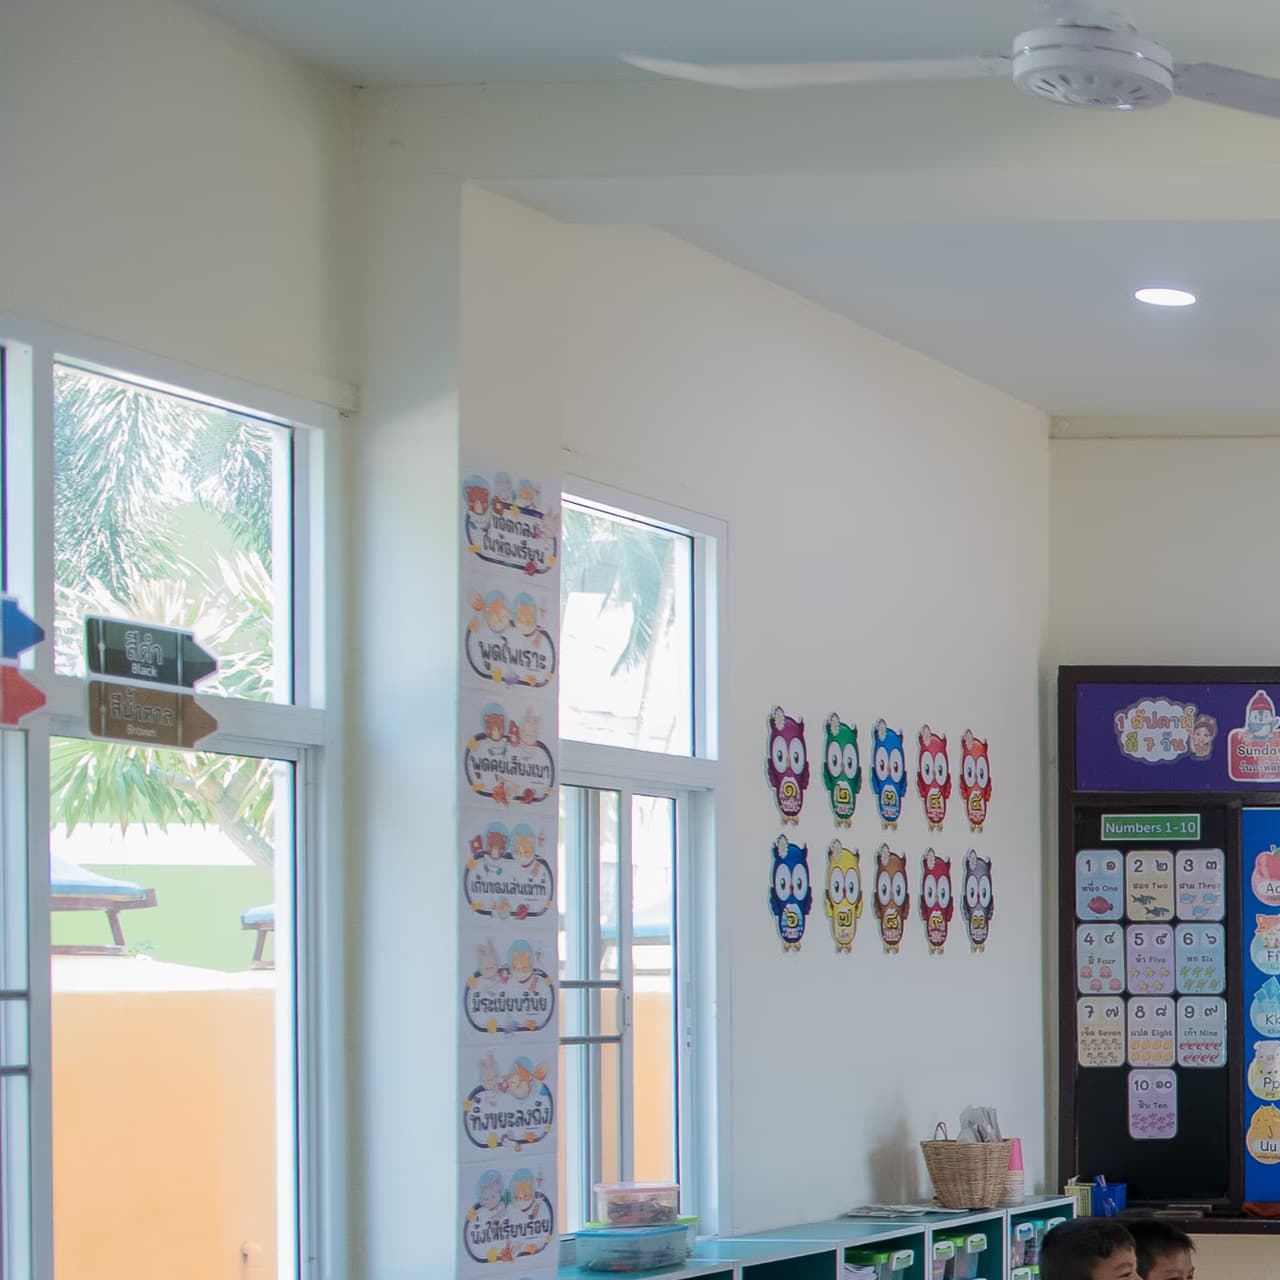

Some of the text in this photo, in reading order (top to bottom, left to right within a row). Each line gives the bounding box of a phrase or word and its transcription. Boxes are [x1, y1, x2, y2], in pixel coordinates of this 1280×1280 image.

[479, 636, 547, 670] พูดไพเราะ
[131, 663, 158, 677] Black
[1131, 709, 1194, 730] สัปดาห์
[470, 755, 549, 781] พูดคุยเสียงเบา
[1105, 822, 1162, 833] Numbers
[1084, 858, 1092, 872] 1
[1134, 859, 1143, 872] 2
[1183, 858, 1194, 872] 3
[471, 873, 546, 896] เก็บของเล่นเข้าที่
[1083, 932, 1095, 946] 4
[1134, 932, 1144, 946] 5
[1182, 932, 1194, 946] 6
[1266, 950, 1280, 961] Ff
[472, 992, 547, 1013] มีระเบียบวินัย
[1084, 1005, 1095, 1019] 7
[1134, 1005, 1146, 1019] 8
[1184, 1005, 1195, 1018] 9
[1133, 1079, 1149, 1091] 10
[1263, 1078, 1280, 1092] Pp
[470, 1097, 550, 1131] ทิ้งขยะลงถัง
[1260, 1141, 1277, 1152] Uu
[471, 1214, 549, 1244] นั่งให้เรียบร้อย
